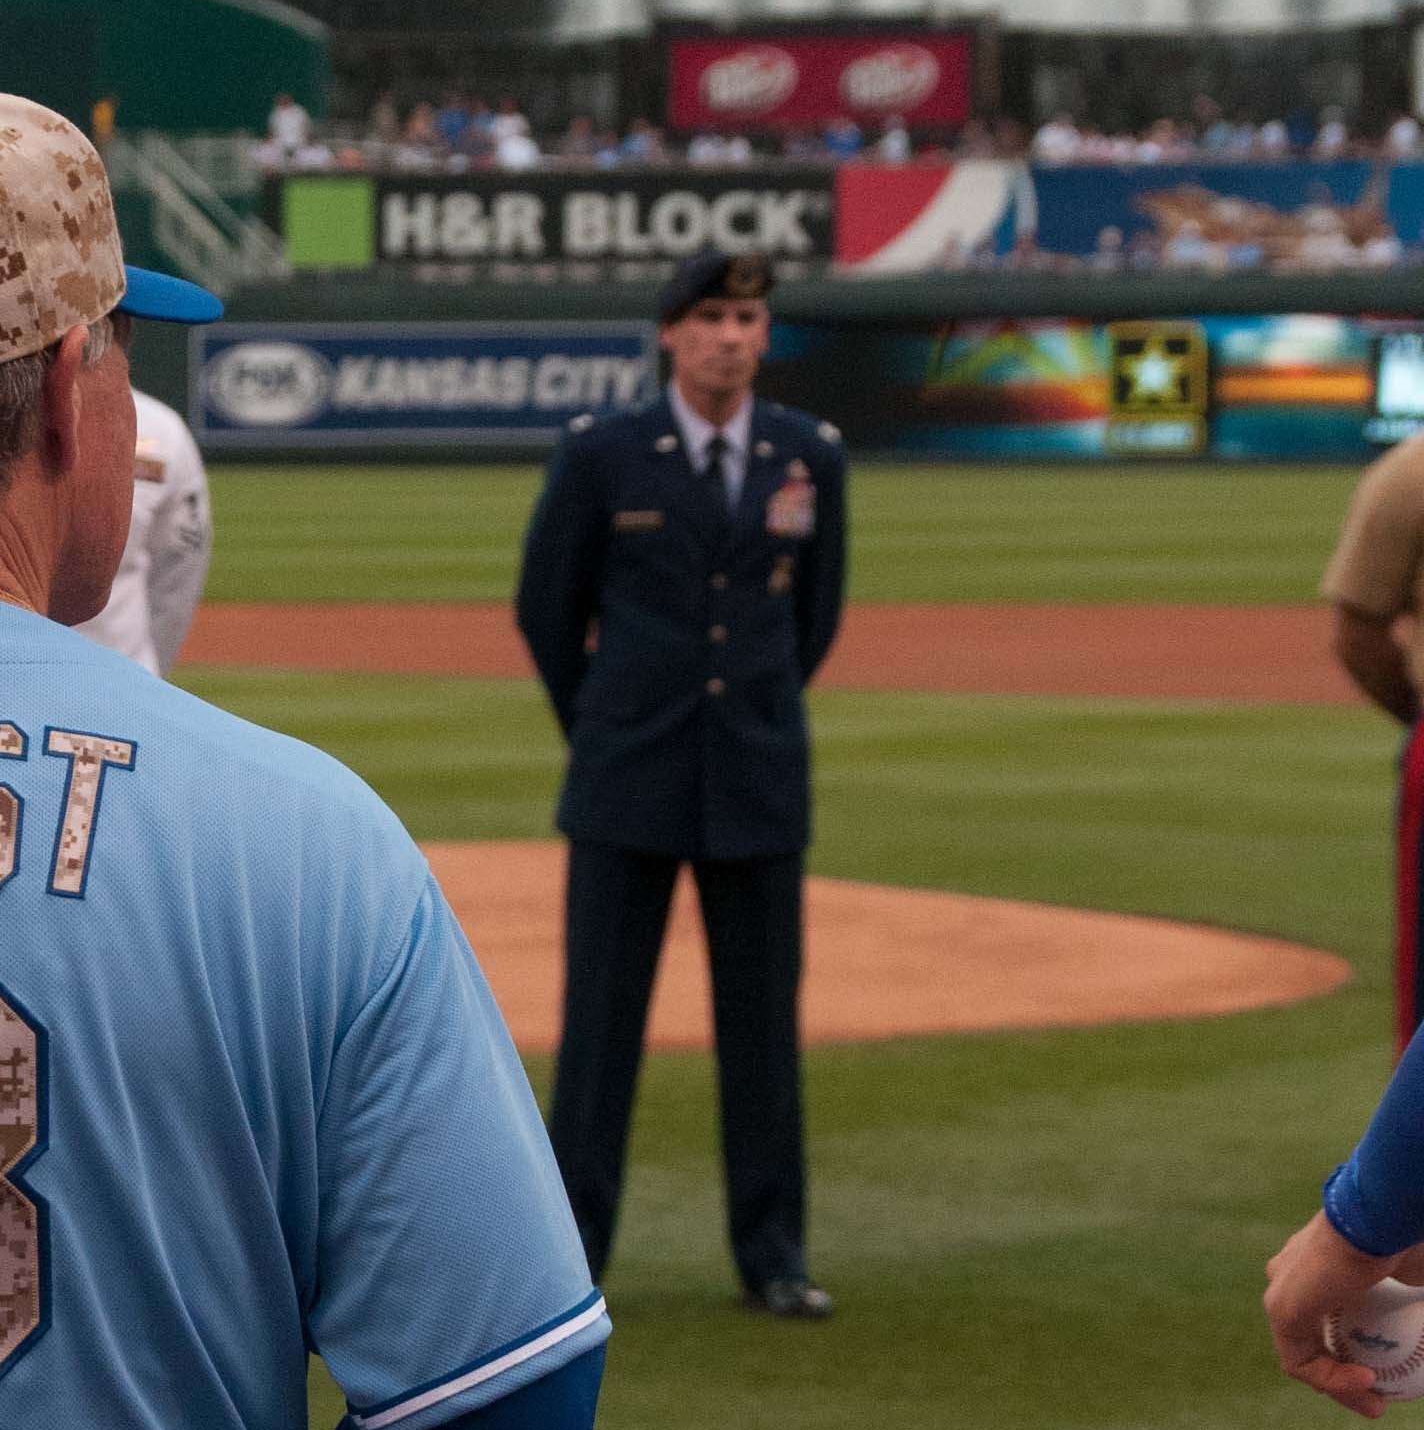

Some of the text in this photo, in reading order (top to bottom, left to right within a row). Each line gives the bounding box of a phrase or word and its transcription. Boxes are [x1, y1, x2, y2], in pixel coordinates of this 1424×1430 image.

[381, 190, 814, 255] H&R BLOCK
[334, 357, 519, 409] KANSAS
[533, 354, 644, 410] CITY
